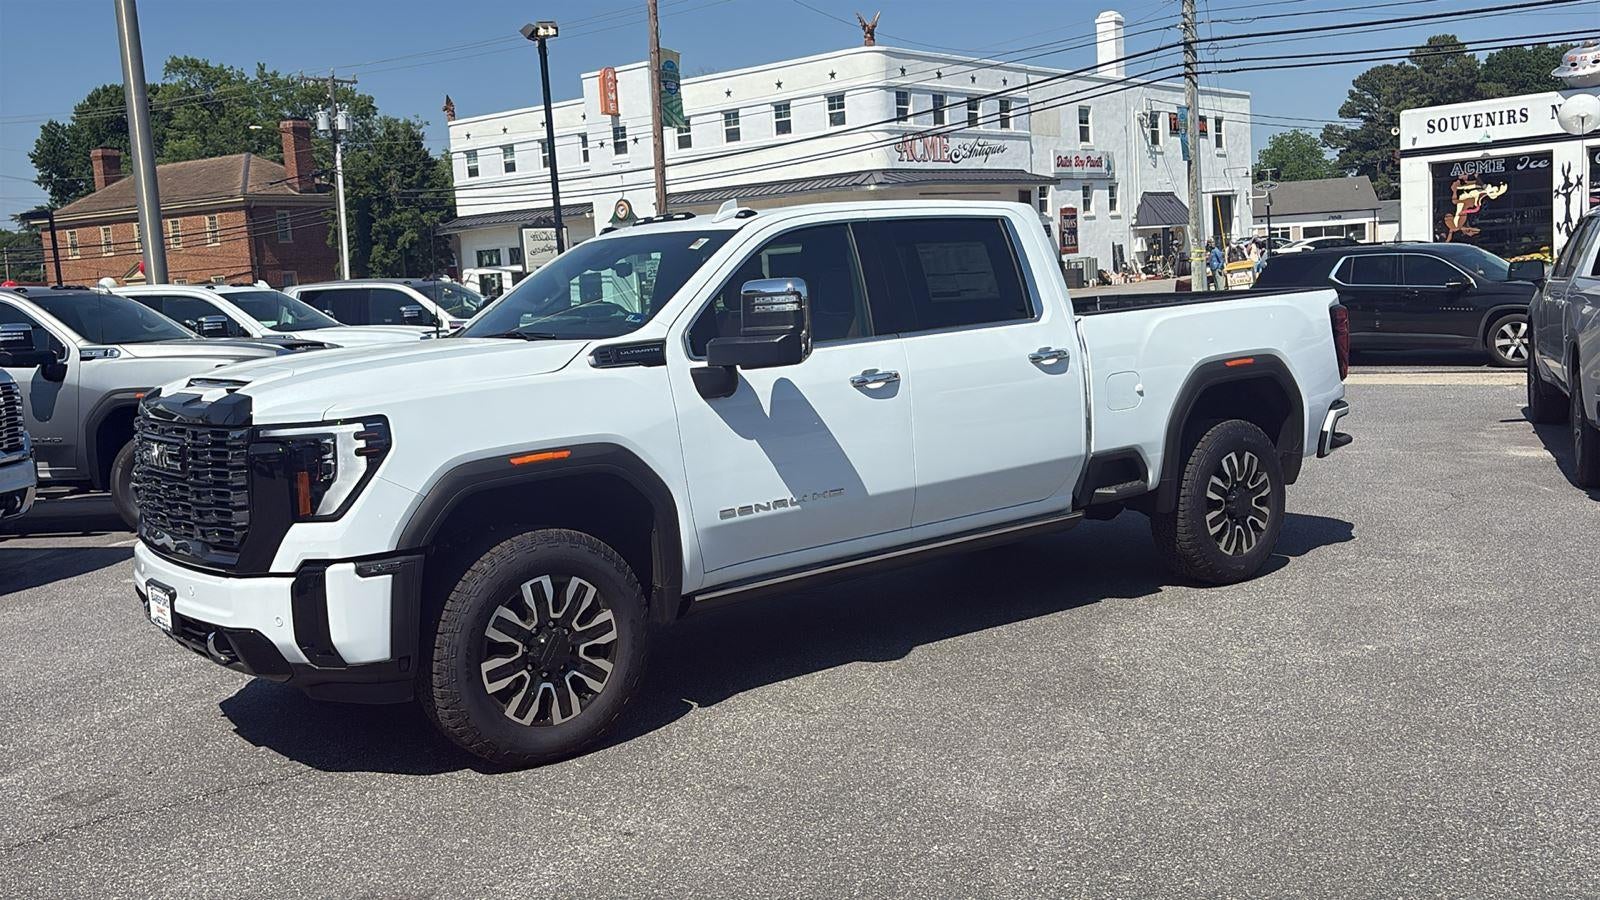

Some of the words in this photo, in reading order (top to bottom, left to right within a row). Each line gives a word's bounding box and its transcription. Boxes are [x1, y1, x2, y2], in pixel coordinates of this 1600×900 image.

[606, 71, 617, 111] ACME
[1427, 108, 1529, 134] SOUVENIRS
[895, 132, 950, 162] ACME
[950, 136, 1008, 164] Antiques
[1074, 155, 1086, 170] Boy
[1451, 159, 1506, 177] ACME
[1516, 155, 1551, 171] Ice
[1063, 233, 1076, 246] TEA
[619, 347, 660, 355] ULTIMATE
[719, 496, 808, 520] DENALI
